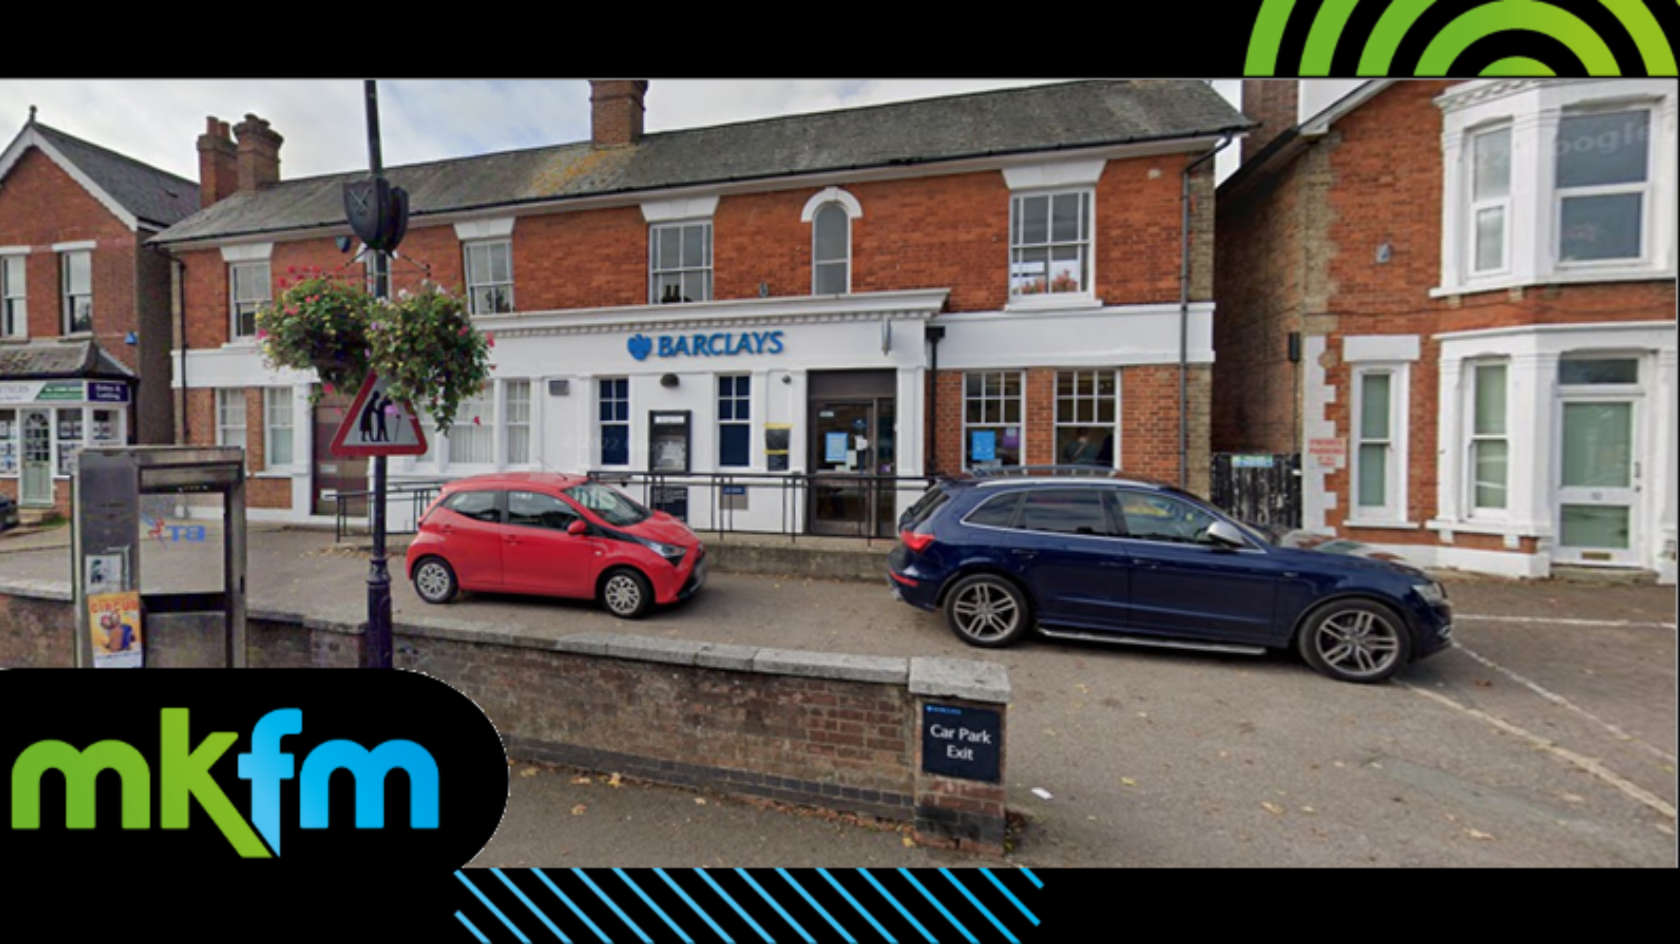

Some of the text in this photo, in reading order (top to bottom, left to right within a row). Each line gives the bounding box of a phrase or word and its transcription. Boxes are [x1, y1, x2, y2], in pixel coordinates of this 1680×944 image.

[657, 330, 784, 358] BARCLAYS
[930, 724, 992, 744] Car Park
[947, 744, 974, 761] Exit
